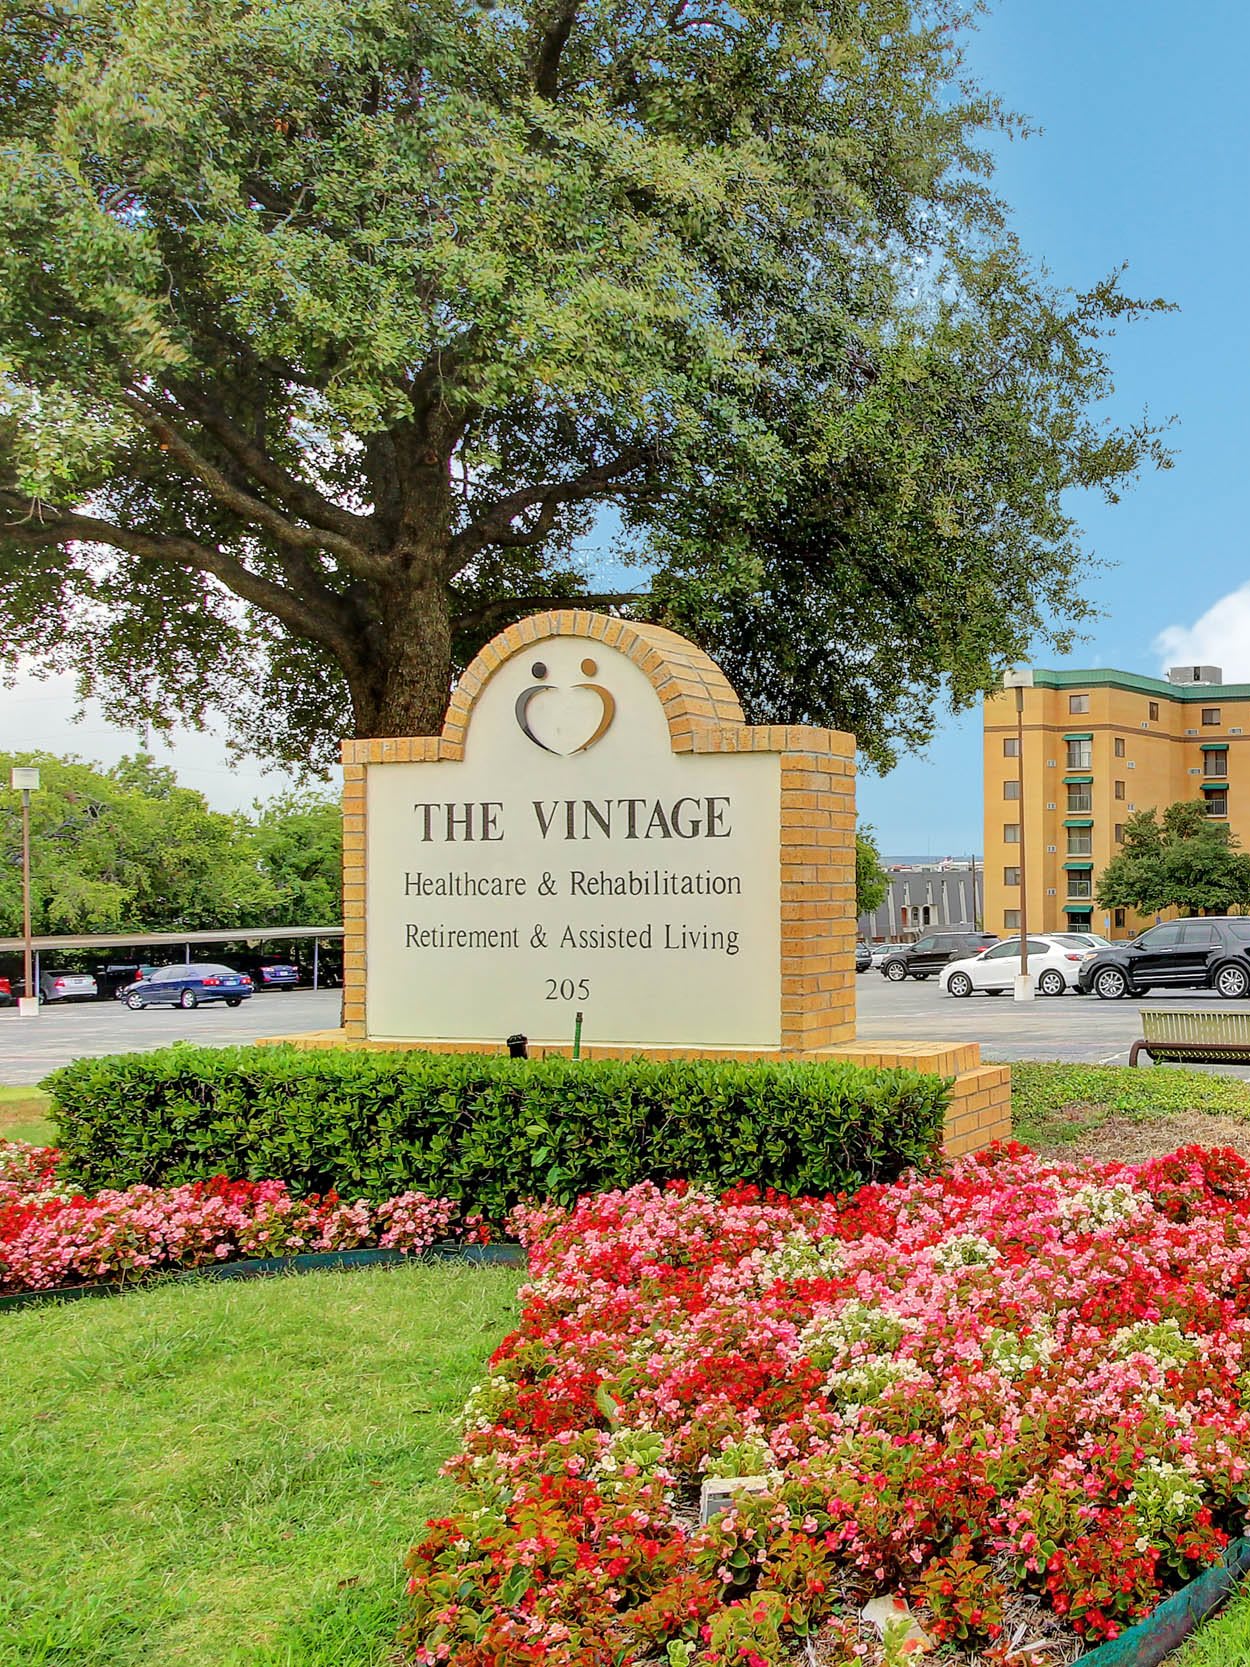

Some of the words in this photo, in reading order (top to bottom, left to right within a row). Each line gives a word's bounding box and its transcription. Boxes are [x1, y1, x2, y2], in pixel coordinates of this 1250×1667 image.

[414, 802, 505, 842] THE
[532, 796, 732, 841] VINTAGE
[404, 871, 527, 897] Healthcare
[537, 871, 558, 897] &
[570, 869, 742, 896] Rehabilitation
[405, 923, 520, 949] Retirement
[529, 923, 548, 949] &
[560, 923, 653, 950] Assisted
[663, 923, 740, 956] Living
[545, 978, 590, 1001] 205
